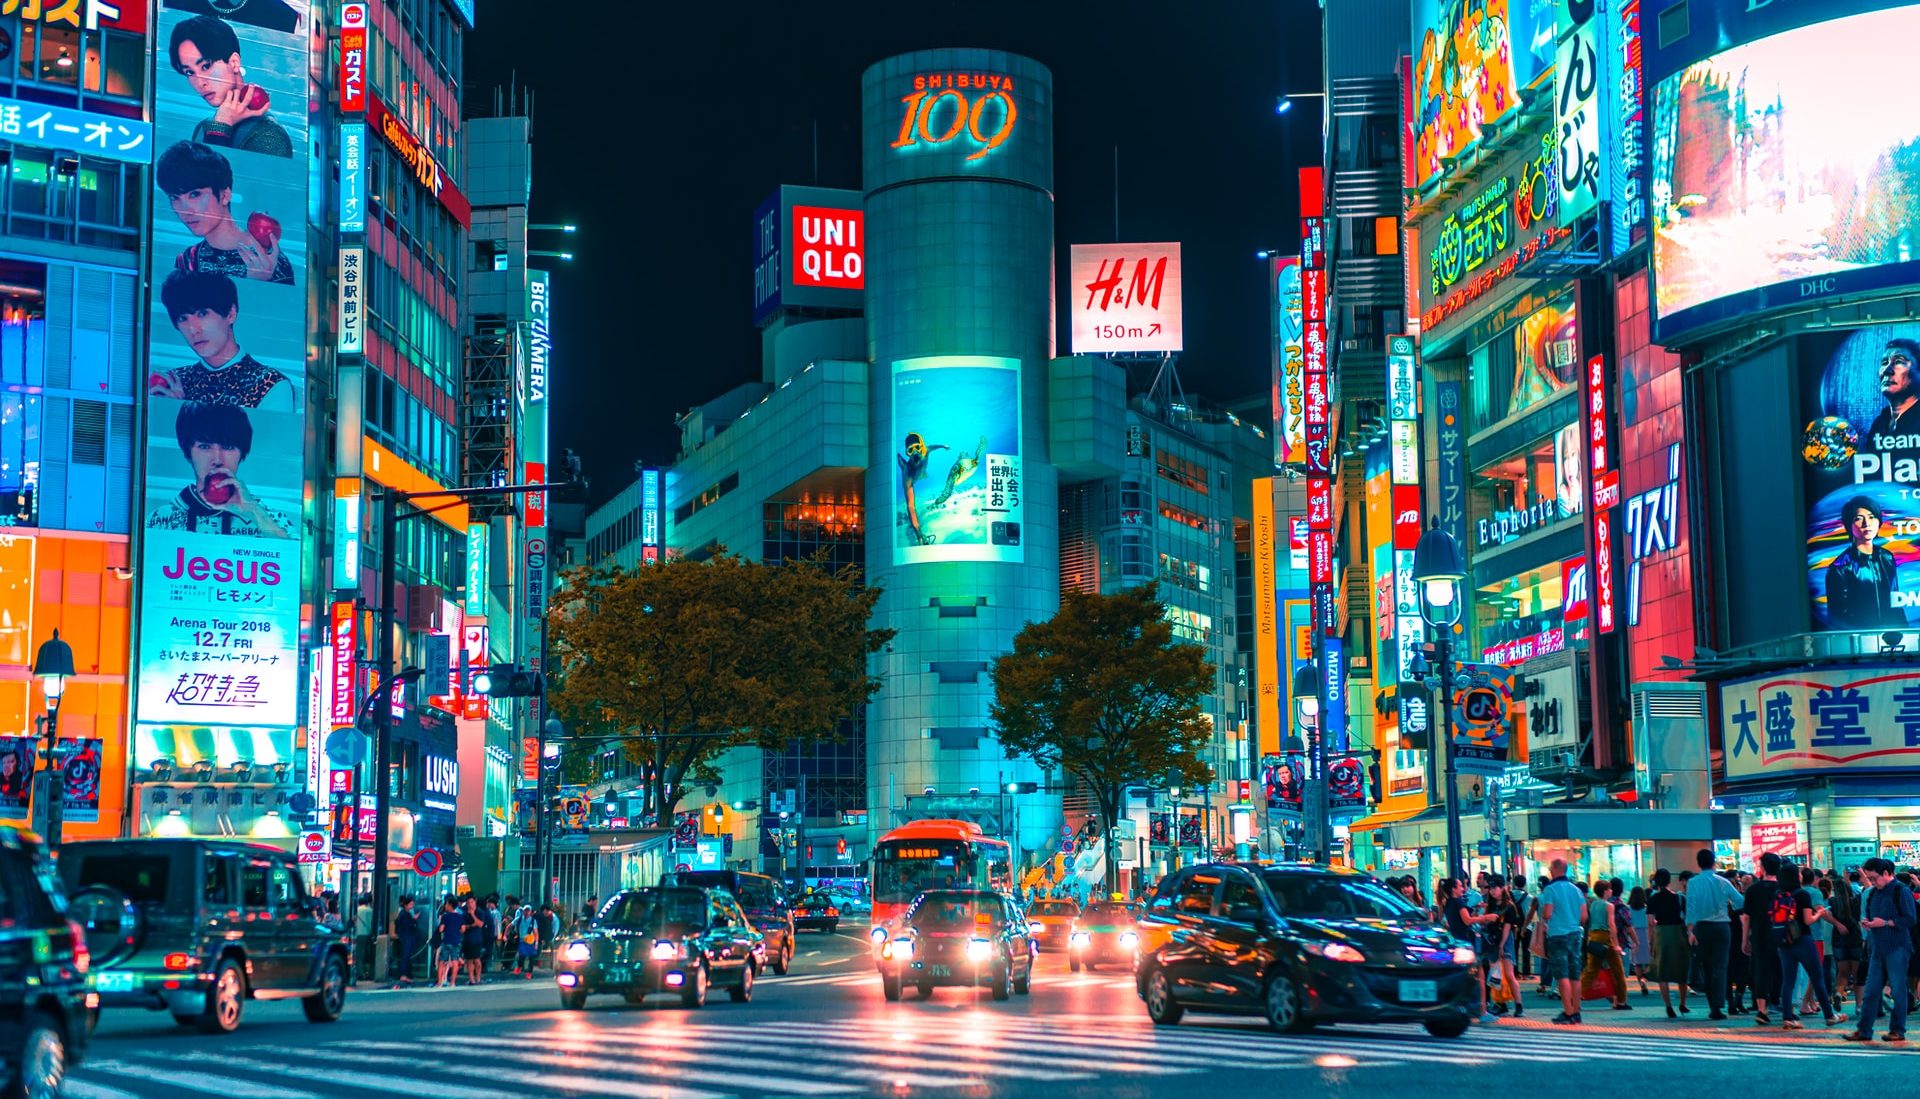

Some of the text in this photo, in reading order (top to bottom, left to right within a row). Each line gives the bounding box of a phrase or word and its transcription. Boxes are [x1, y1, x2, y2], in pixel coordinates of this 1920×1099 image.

[345, 49, 362, 100] ガスト
[914, 75, 1014, 91] SHIBUYA
[890, 88, 1018, 161] 109
[345, 135, 359, 221] 英会話イーオン
[758, 207, 776, 260] THE
[802, 215, 857, 247] UNI
[754, 249, 780, 310] PRIME
[802, 249, 862, 281] QLO
[343, 254, 358, 344] 渋谷駅前ビル
[530, 281, 545, 314] BIC
[1085, 255, 1168, 312] H&M
[1800, 278, 1836, 297] DHC
[1094, 324, 1143, 339] 150m
[990, 465, 1019, 478] 世界に
[1854, 451, 1920, 485] Pla
[1441, 430, 1463, 552] サマーフルー
[1397, 510, 1419, 524] JTB
[1478, 494, 1554, 546] Euphoria
[162, 547, 281, 586] Jesus
[232, 548, 281, 559] NEW SINGLE
[527, 539, 546, 568] OS
[1262, 561, 1271, 635] Matsumoto
[170, 616, 271, 632] Arena Tour 2018
[193, 631, 253, 649] 12.7 FRI
[159, 650, 280, 665] さいたまスーパーアリーナ
[165, 672, 269, 708] 超特急
[1327, 651, 1339, 701] MIZUHO
[1407, 697, 1427, 732] HUB
[1466, 748, 1494, 759] Tik Tok
[426, 755, 458, 796] LUSH
